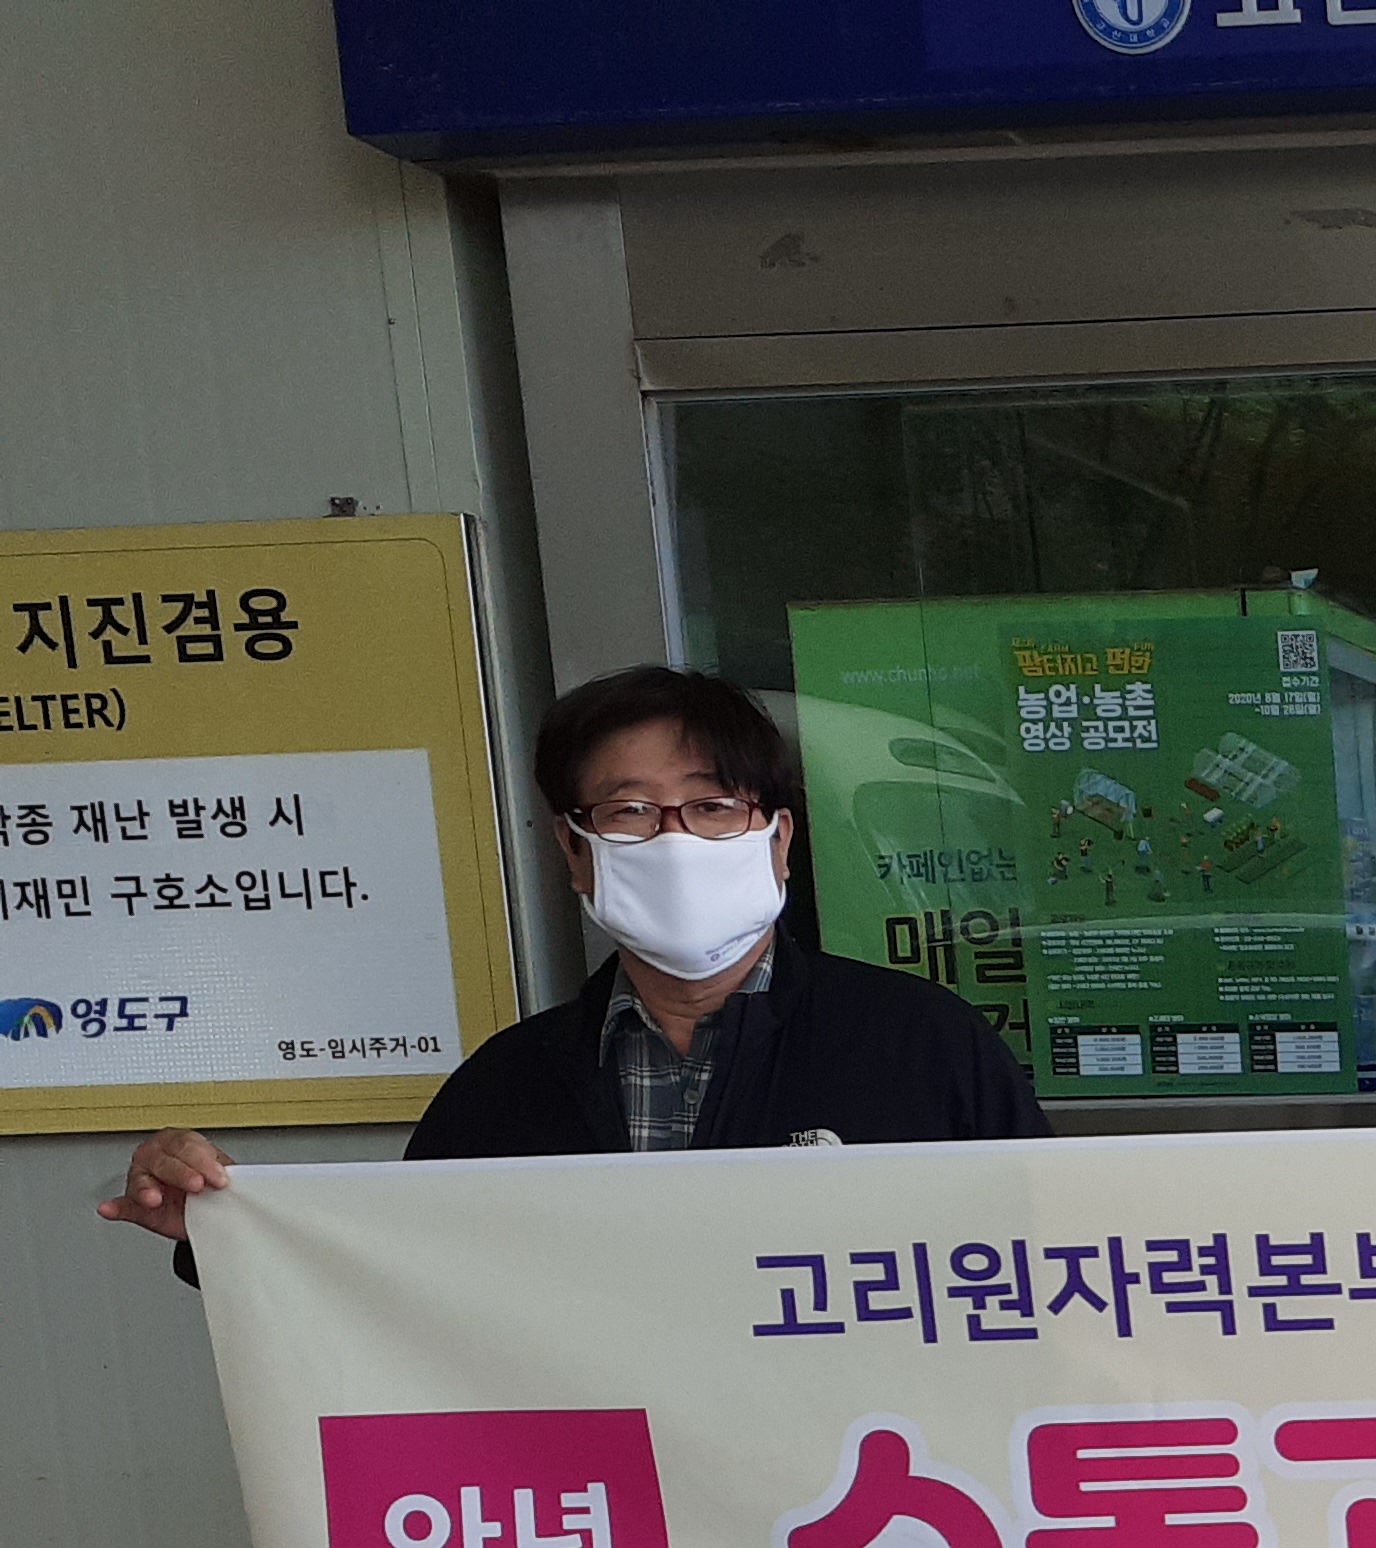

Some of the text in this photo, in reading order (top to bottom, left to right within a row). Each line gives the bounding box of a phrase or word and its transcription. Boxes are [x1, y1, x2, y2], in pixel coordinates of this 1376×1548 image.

[12, 587, 300, 670] 지진겸용
[1019, 719, 1160, 751] 영상 공모전
[73, 797, 152, 843] 재난
[168, 794, 248, 840] 발생
[268, 793, 305, 837] 시
[877, 847, 1018, 885] 카페인없는
[109, 865, 370, 918] 구호소입니다.
[885, 907, 1028, 986] 매일
[70, 994, 190, 1040] 영도구
[277, 1035, 442, 1061] 영도-임시주거-01
[790, 1129, 817, 1143] THE
